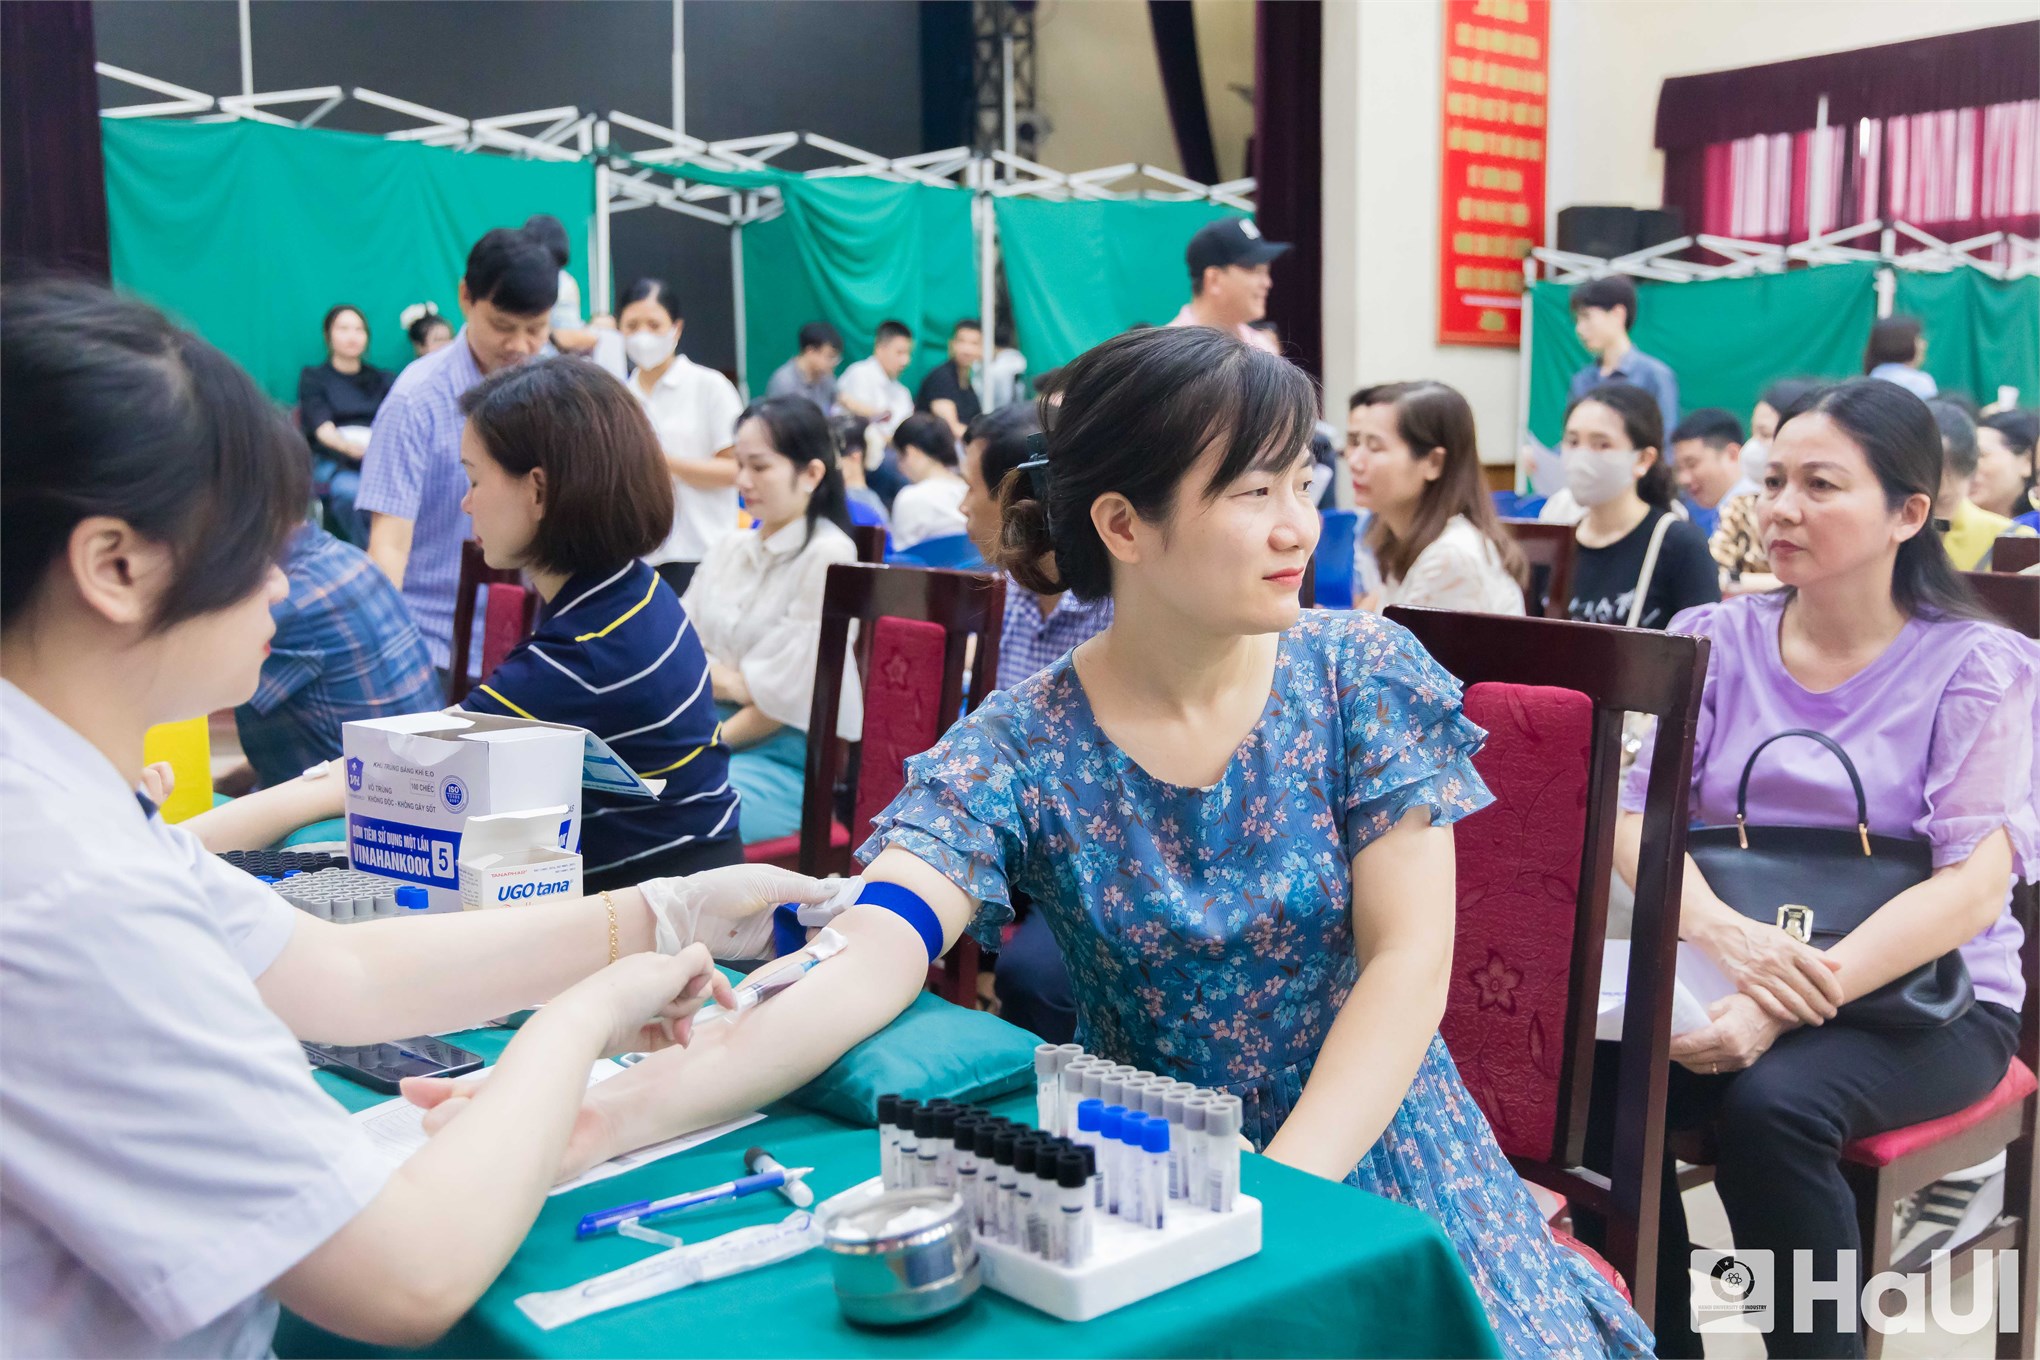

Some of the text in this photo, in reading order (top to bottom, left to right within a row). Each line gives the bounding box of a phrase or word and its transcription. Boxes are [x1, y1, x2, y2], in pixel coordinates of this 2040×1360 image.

[448, 785, 460, 794] ISO
[397, 800, 414, 810] KHÔNG
[353, 843, 431, 878] VINAHANKOOK
[439, 847, 449, 871] 5
